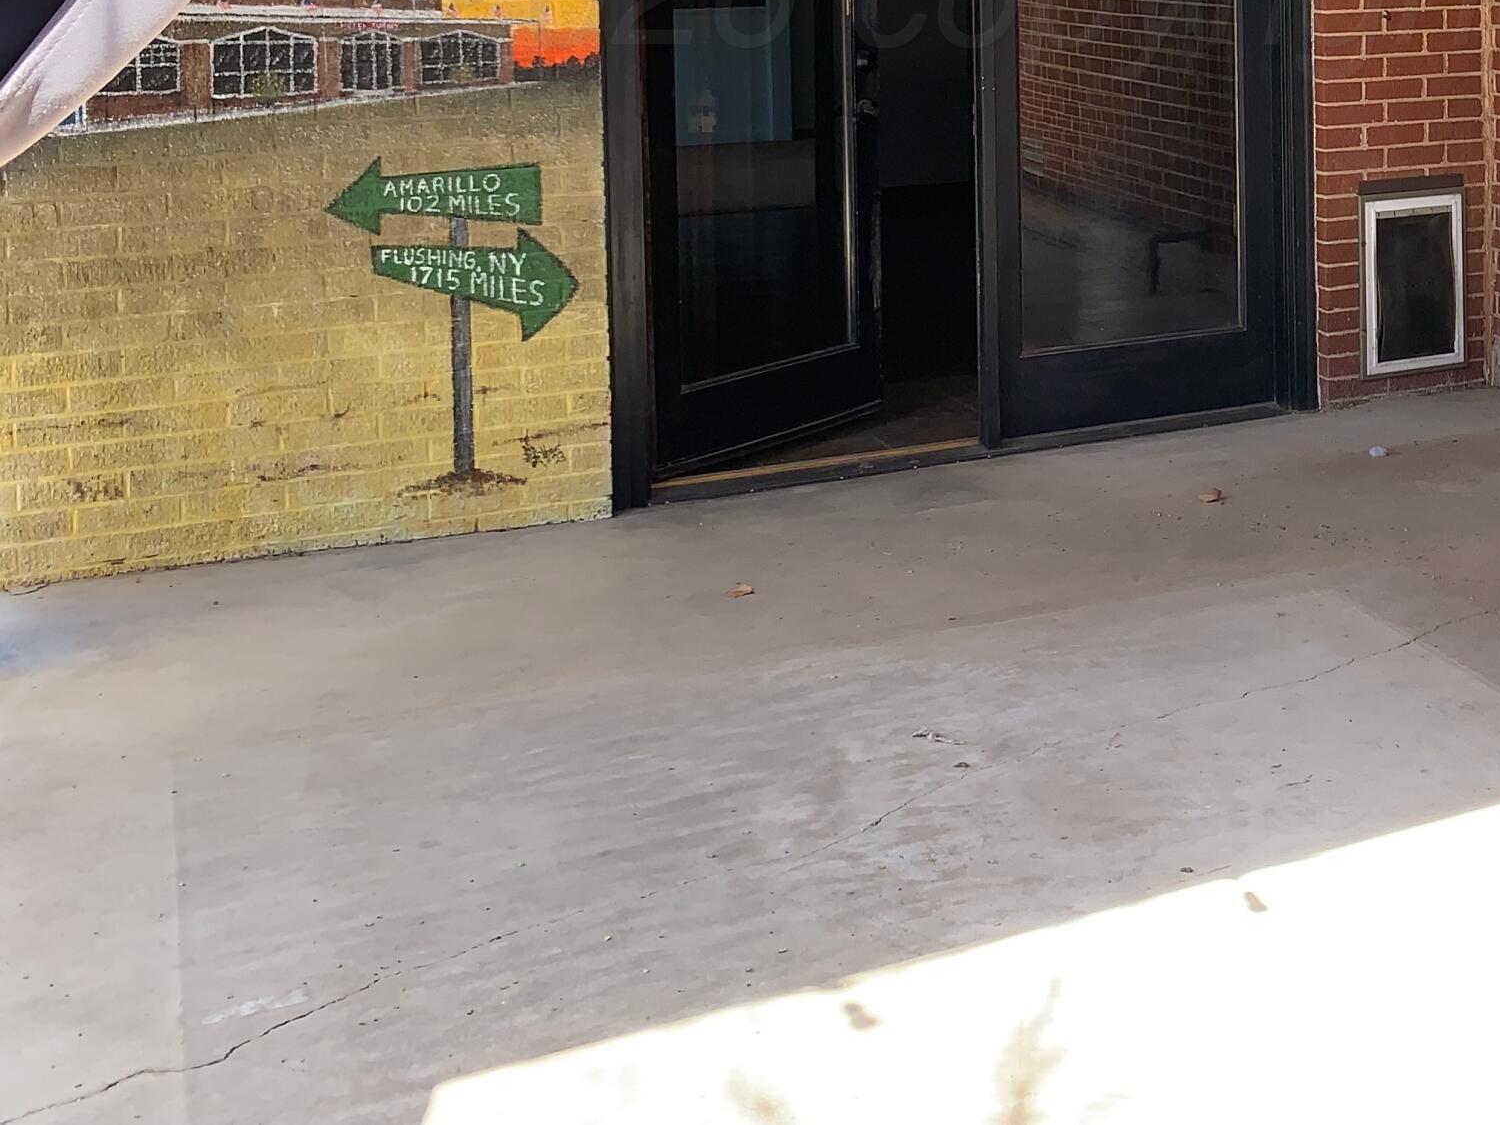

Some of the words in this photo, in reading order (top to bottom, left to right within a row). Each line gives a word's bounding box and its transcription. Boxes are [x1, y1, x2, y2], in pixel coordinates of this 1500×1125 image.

[382, 173, 501, 198] AMARILLO
[400, 195, 441, 213] 102
[449, 192, 521, 217] MILES
[489, 251, 527, 276] NY
[410, 266, 461, 290] 1715
[470, 271, 546, 307] MILES
